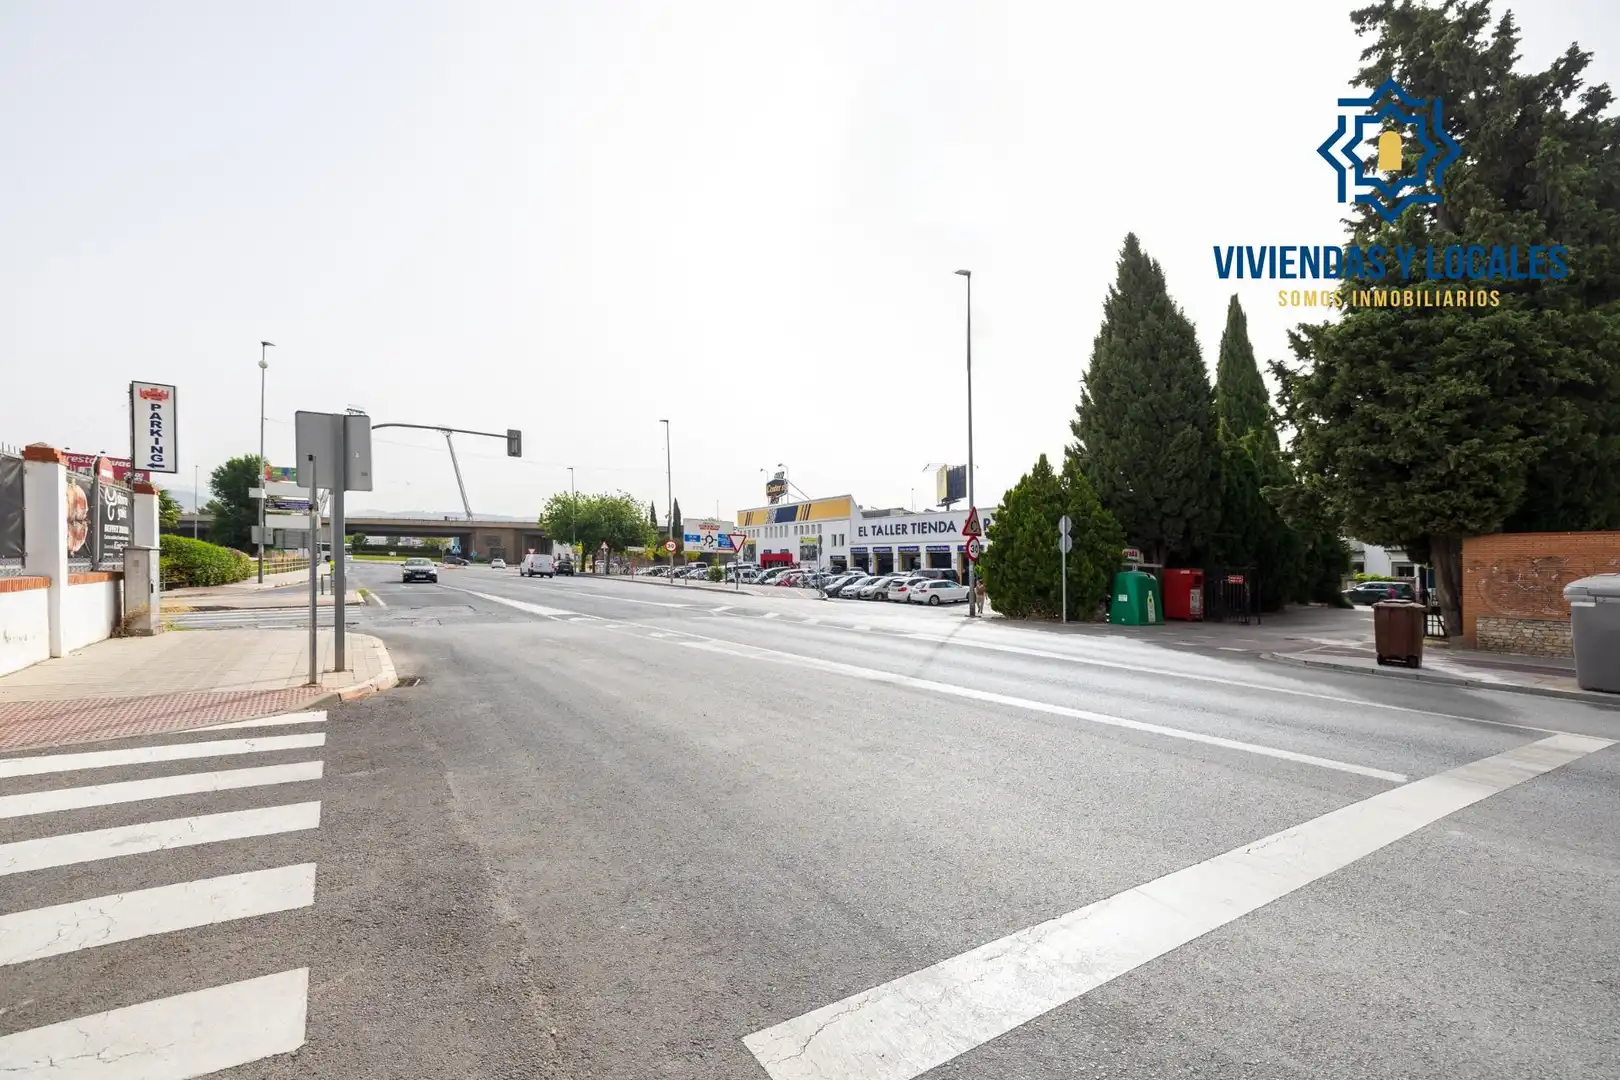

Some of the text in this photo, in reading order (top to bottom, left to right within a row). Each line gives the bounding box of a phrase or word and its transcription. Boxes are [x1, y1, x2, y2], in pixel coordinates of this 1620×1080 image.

[149, 403, 163, 462] PARKING
[858, 526, 868, 537] EL
[871, 523, 908, 536] TALLER
[910, 520, 957, 534] TIENDA
